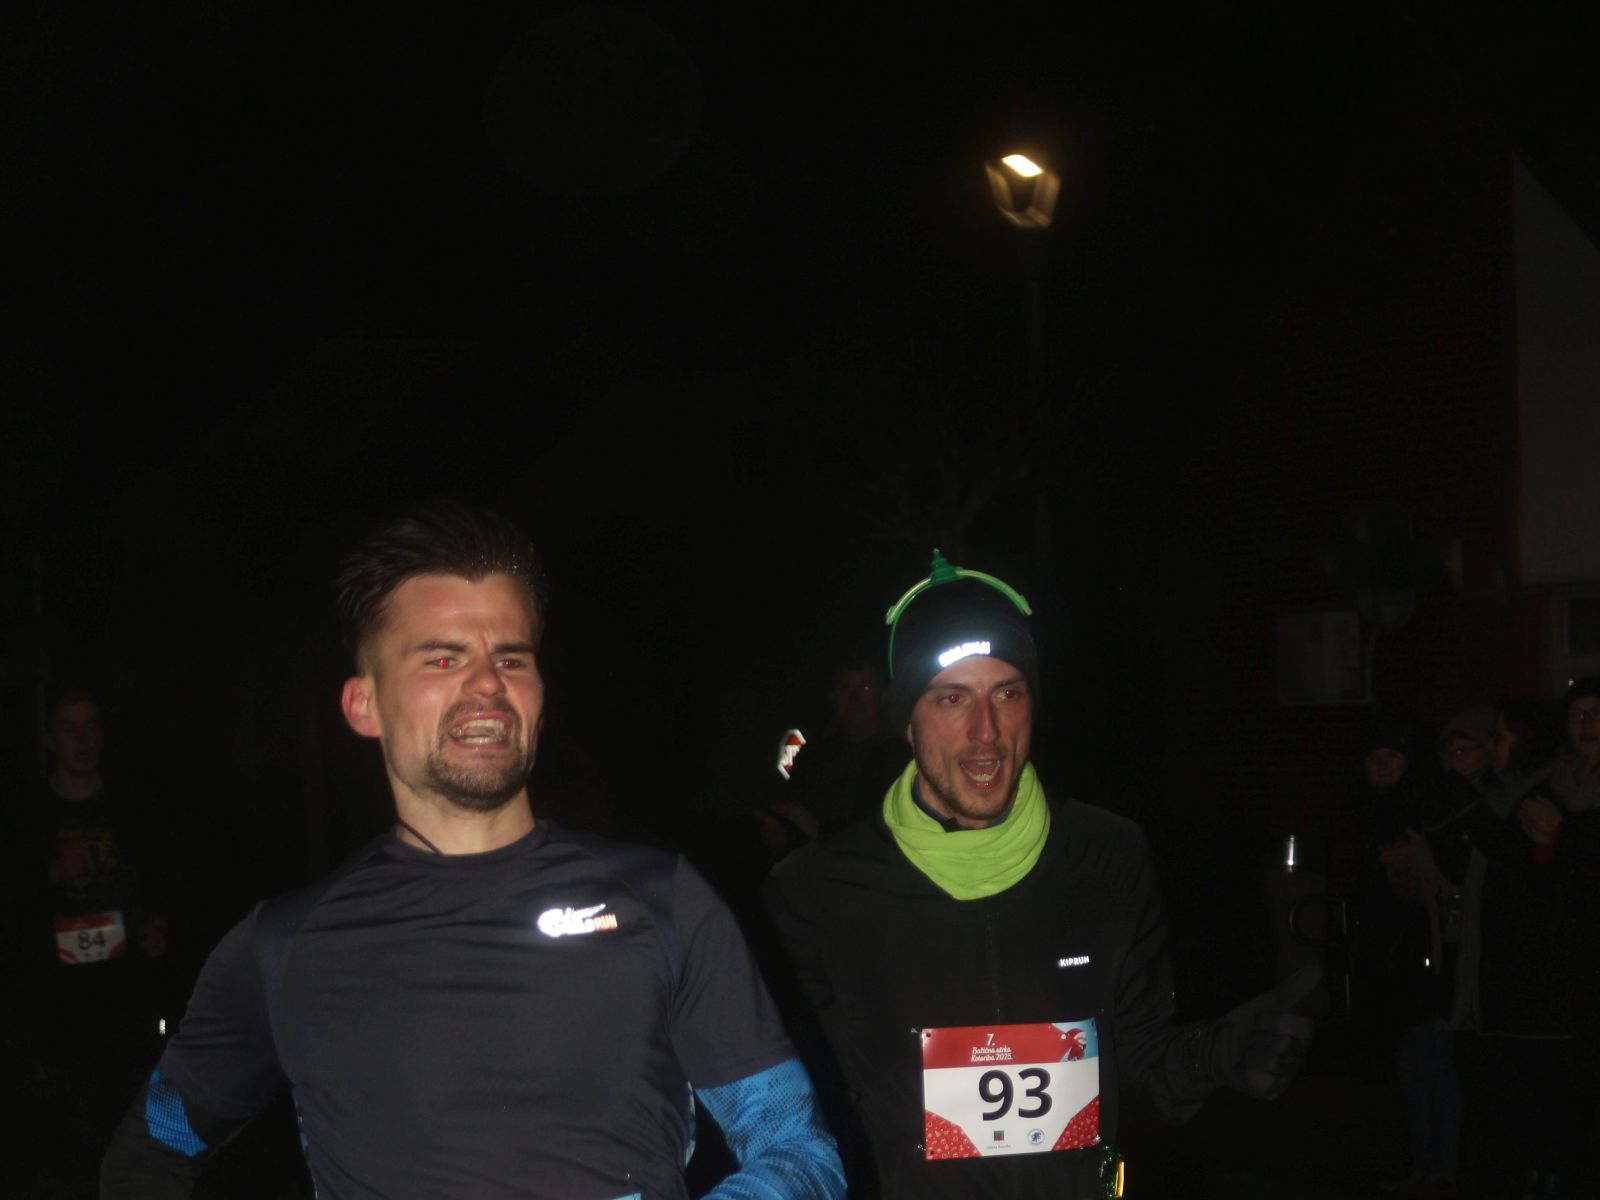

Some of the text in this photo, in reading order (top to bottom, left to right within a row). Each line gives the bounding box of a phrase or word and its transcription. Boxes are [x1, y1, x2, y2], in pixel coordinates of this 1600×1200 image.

[78, 930, 106, 950] 84
[1058, 955, 1090, 967] KIPRUN
[986, 1033, 996, 1046] 7.
[978, 1067, 1053, 1121] 93
